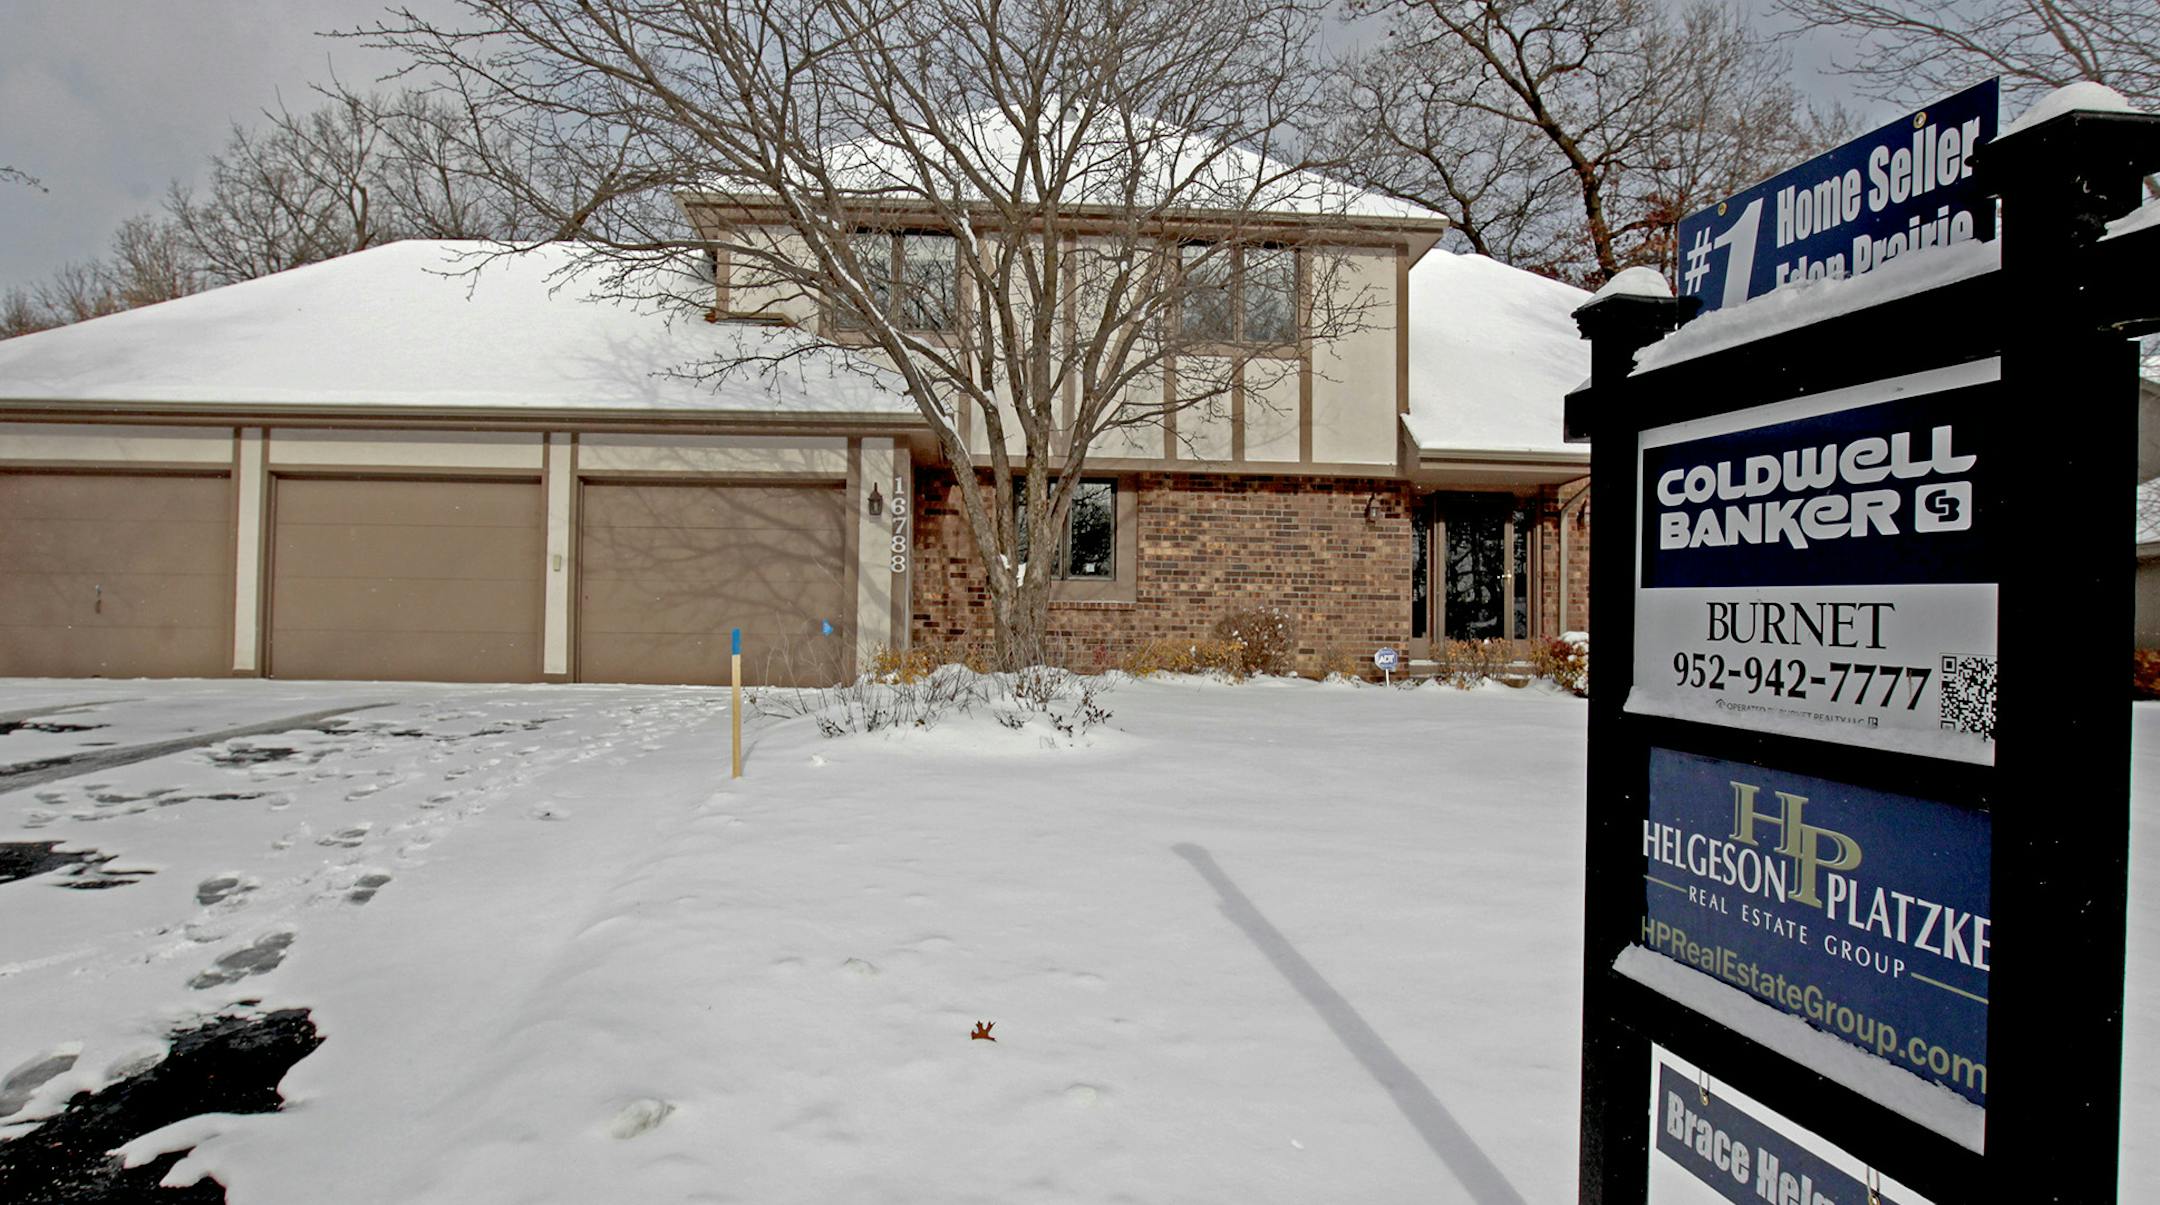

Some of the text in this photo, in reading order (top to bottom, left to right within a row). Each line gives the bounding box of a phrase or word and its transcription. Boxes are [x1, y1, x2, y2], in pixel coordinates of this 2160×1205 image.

[1685, 115, 1981, 309] #1 Home Seller
[1657, 424, 1977, 507] COLDWELL
[890, 477, 907, 573] 16788
[1660, 489, 1901, 550] BANKER
[1379, 654, 1395, 664] ADT
[1706, 601, 1896, 649] BURNET
[1673, 652, 1932, 711] 952-942-7777
[1730, 781, 1862, 908] HP
[1643, 820, 1991, 972] HELGESON PLATZKE
[1688, 885, 1905, 978] REAL ESTATE GROUP
[1641, 916, 1987, 1094] HPRealEstateGroup.com
[1666, 1090, 1836, 1205] Brace Hel
